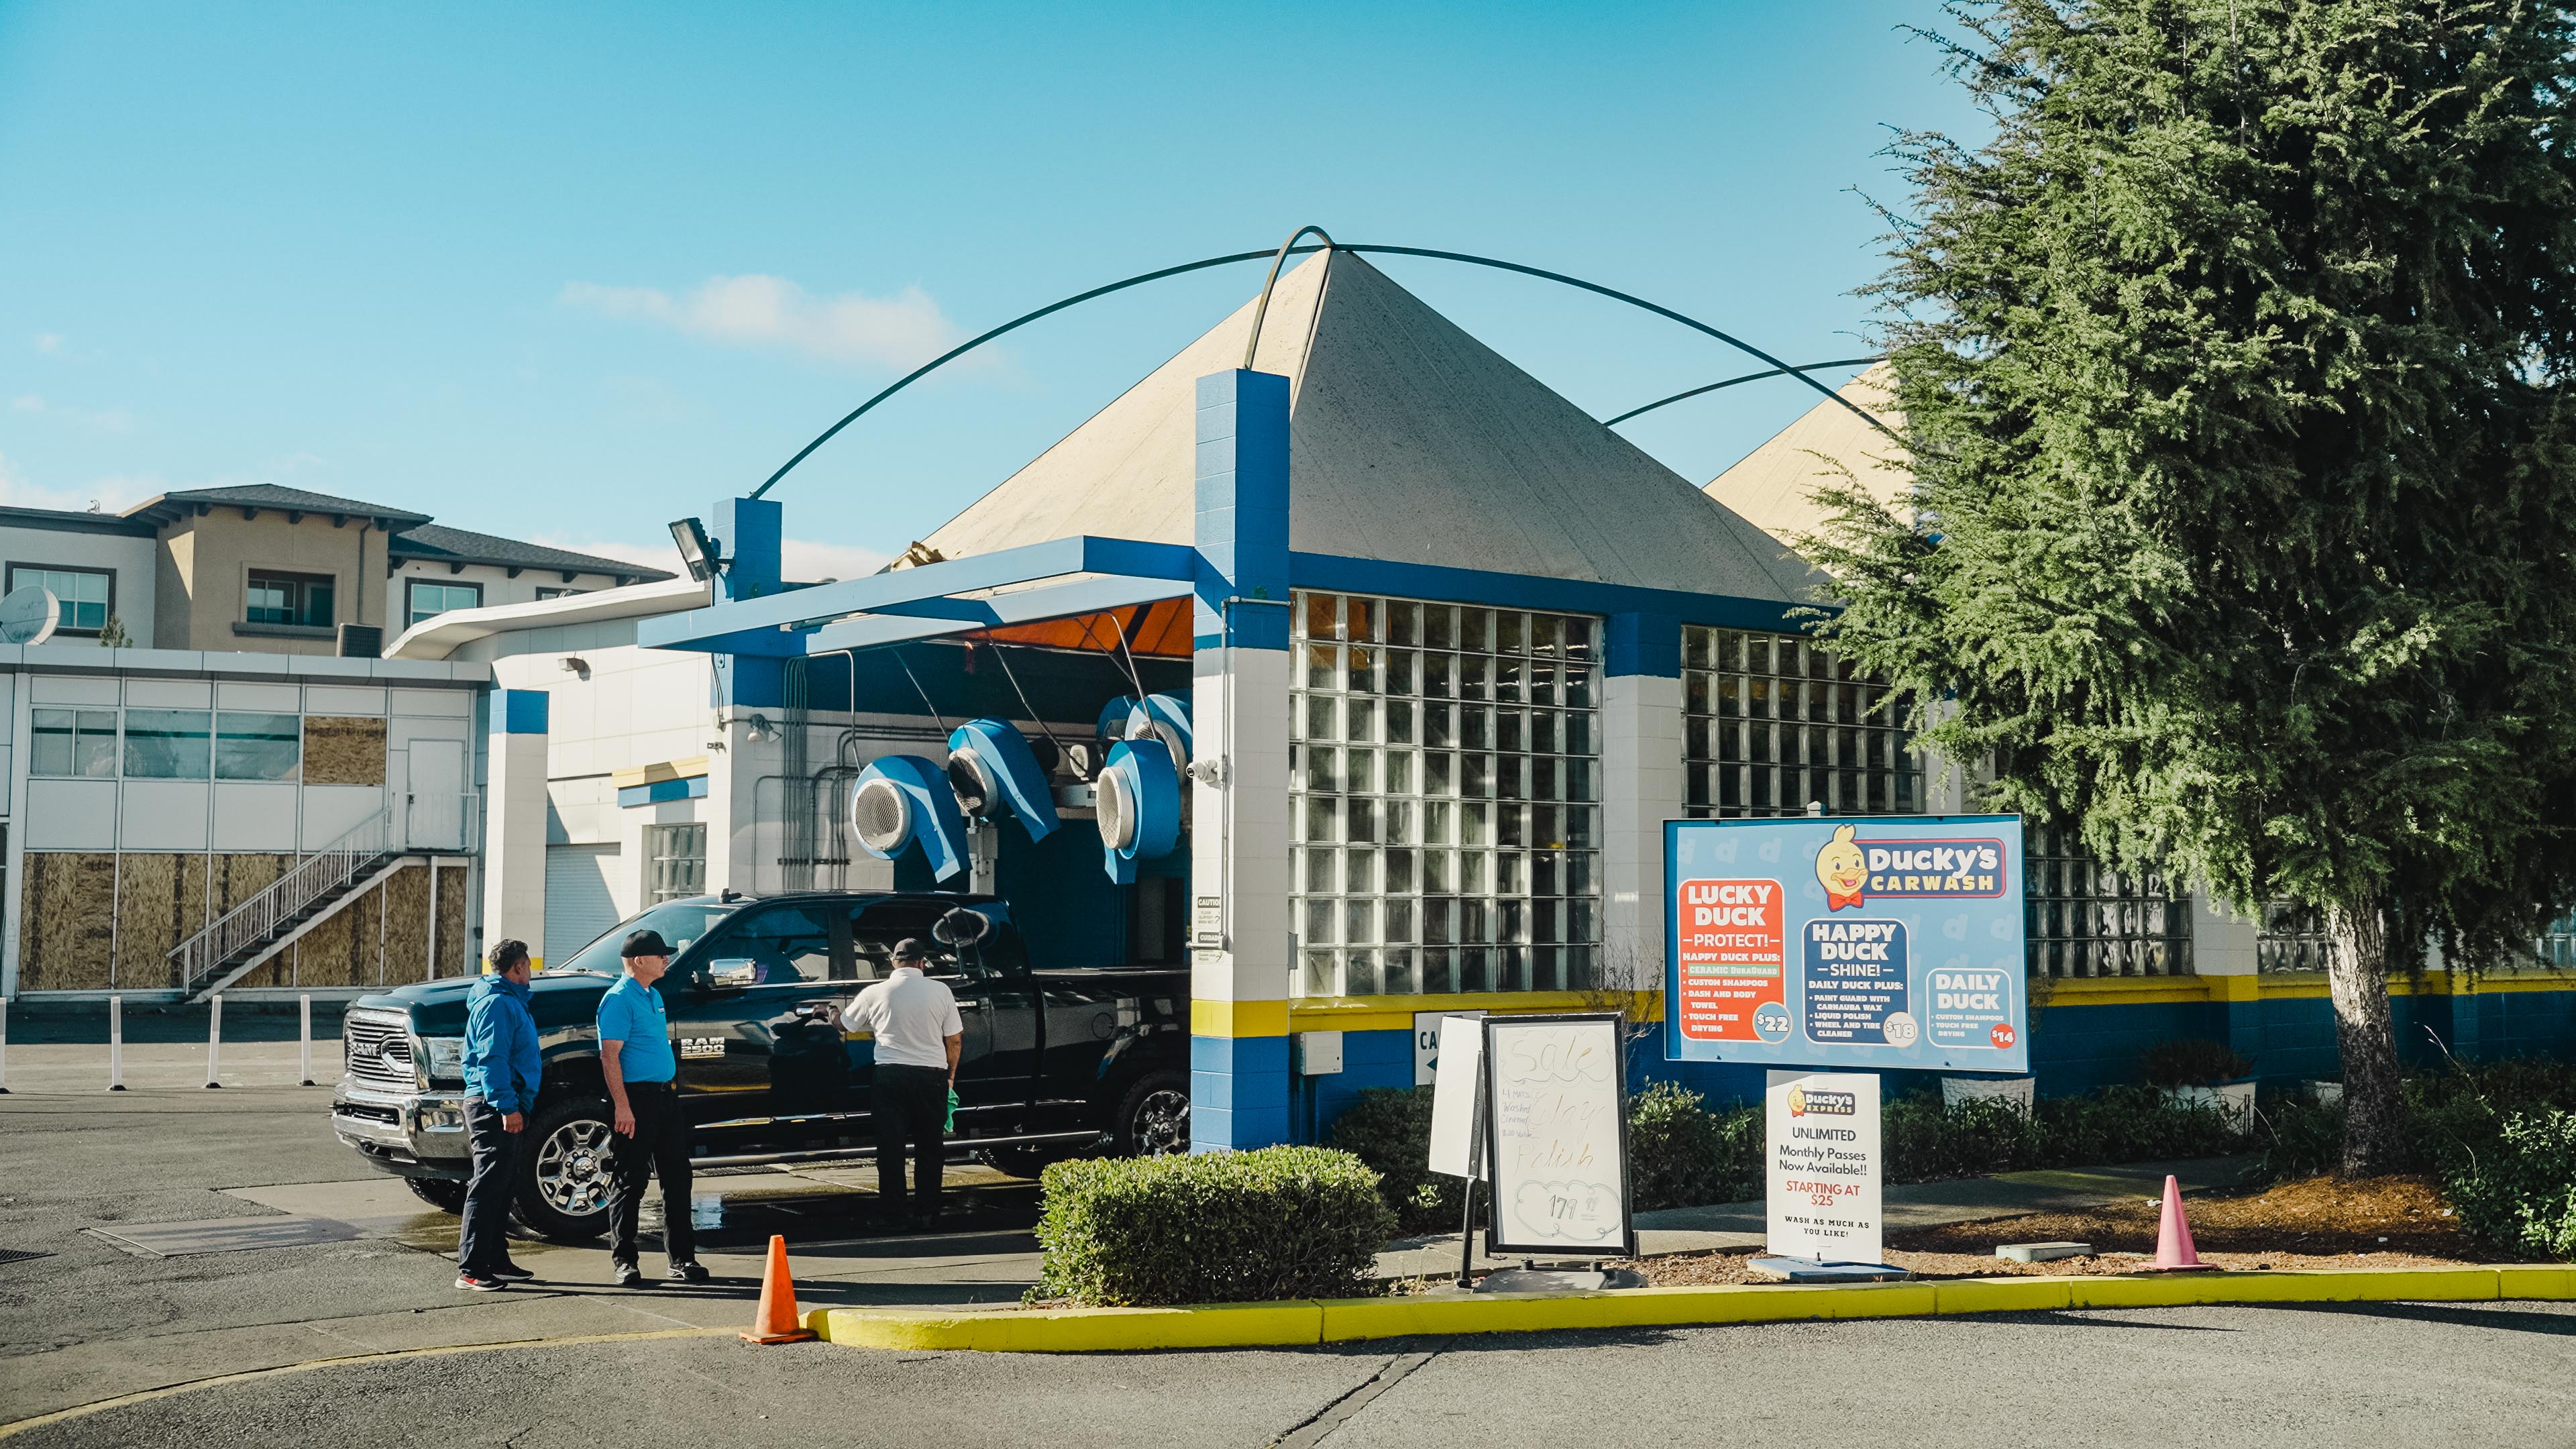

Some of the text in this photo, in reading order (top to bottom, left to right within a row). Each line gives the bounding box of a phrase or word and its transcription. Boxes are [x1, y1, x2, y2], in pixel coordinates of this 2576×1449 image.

[1869, 845, 1998, 879] Ducky's
[1871, 875, 1994, 891] CARWASH
[1688, 885, 1773, 904] LUCKY
[1695, 907, 1766, 926] DUCK
[1694, 933, 1768, 947] PROTECT!
[1812, 924, 1896, 942] HAPPY
[1682, 953, 1780, 961] HAPPY DUCK PLUS:
[1821, 943, 1889, 961] DUCK
[1689, 966, 1728, 974] CERAMIC
[1830, 963, 1880, 976] SHINE!
[1809, 981, 1903, 990] DAILY DUCK PLUS:
[1935, 974, 2000, 990] DAILY
[1937, 993, 2000, 1010] DUCK
[1757, 1013, 1789, 1032] $22
[1886, 1021, 1916, 1038] $18
[681, 1036, 724, 1046] RAM
[1419, 1030, 1438, 1051] CA
[1992, 1030, 2014, 1042] $14
[681, 1044, 724, 1054] 2500
[1511, 1035, 1599, 1072] Sale
[1805, 1093, 1853, 1108] Ducky's
[1806, 1104, 1852, 1114] EXPRESS
[1792, 1127, 1856, 1142] UNLIMITED
[1780, 1144, 1866, 1161] Monthly Passes
[1779, 1160, 1867, 1175] Now Available!!
[1786, 1181, 1860, 1196] STARTING AT
[1811, 1193, 1833, 1207] $25
[1784, 1216, 1810, 1224] WASH
[1829, 1219, 1854, 1228] MUCH
[1804, 1228, 1848, 1238] YOU LIKE!
